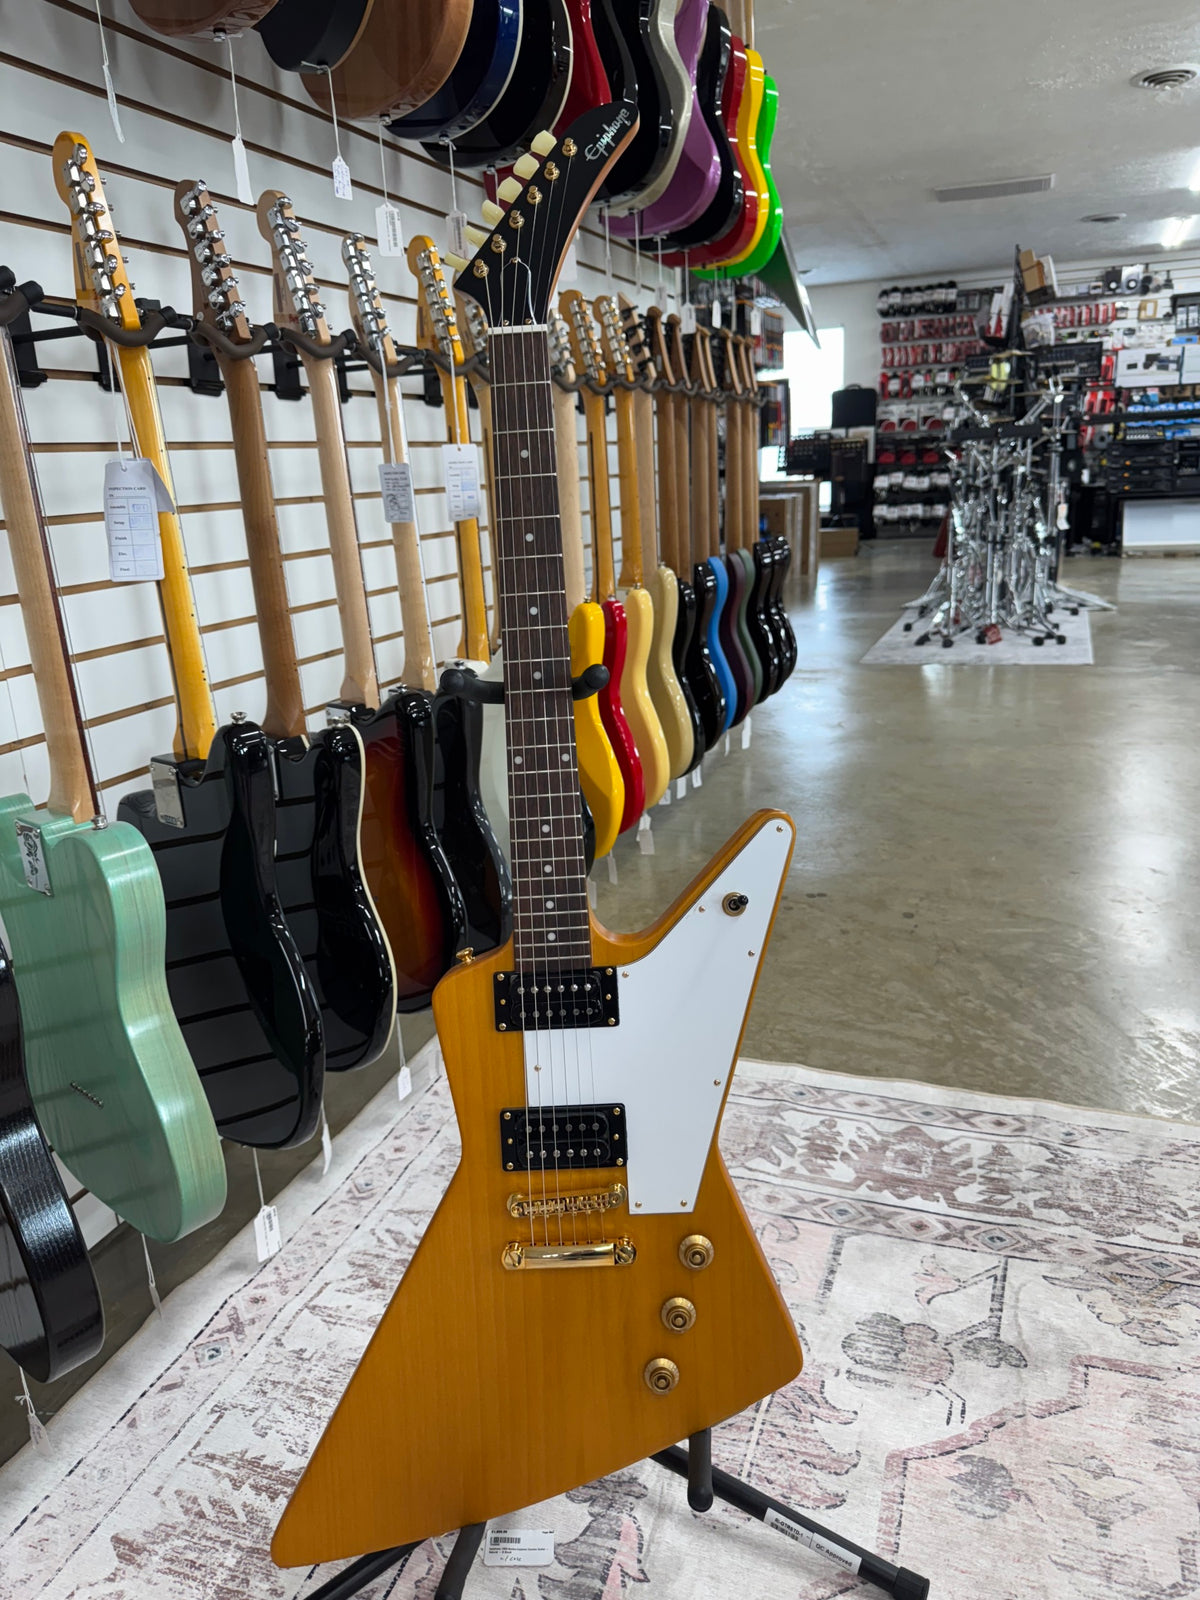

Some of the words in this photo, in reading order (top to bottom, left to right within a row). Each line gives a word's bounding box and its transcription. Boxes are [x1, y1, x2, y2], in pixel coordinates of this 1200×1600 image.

[584, 108, 631, 161] Epiphone
[815, 1543, 825, 1552] QC
[825, 1549, 853, 1567] Approved
